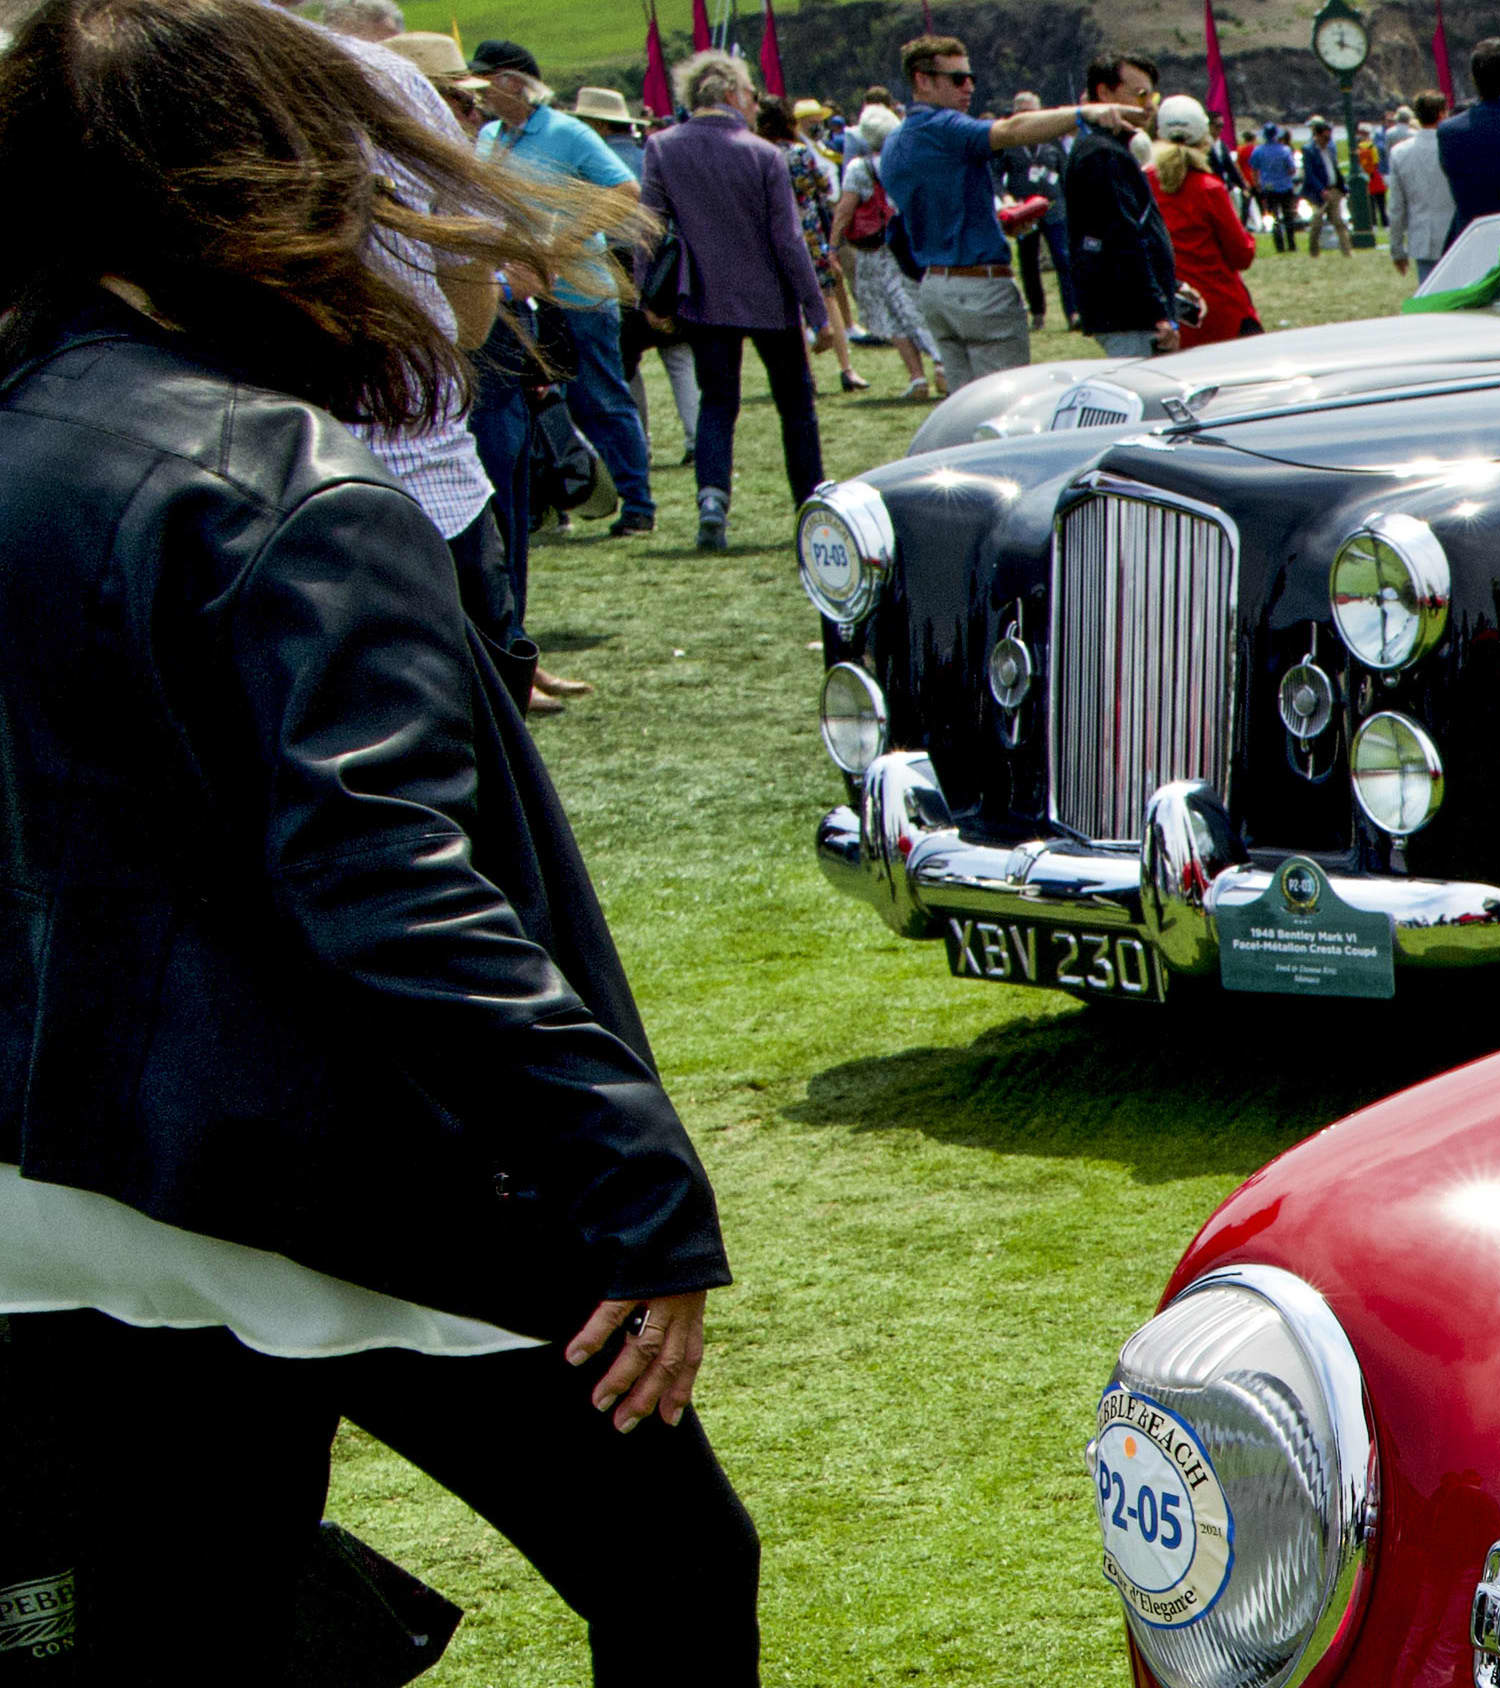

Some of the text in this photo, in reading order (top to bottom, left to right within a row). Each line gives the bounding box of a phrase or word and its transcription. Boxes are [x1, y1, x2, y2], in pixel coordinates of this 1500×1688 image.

[813, 543, 848, 567] P2-03
[1277, 929, 1316, 943] Bentley
[1318, 931, 1343, 942] Mark
[950, 917, 1149, 992] XBV 230
[1100, 1459, 1183, 1550] P2-05
[1200, 1523, 1223, 1538] 2021
